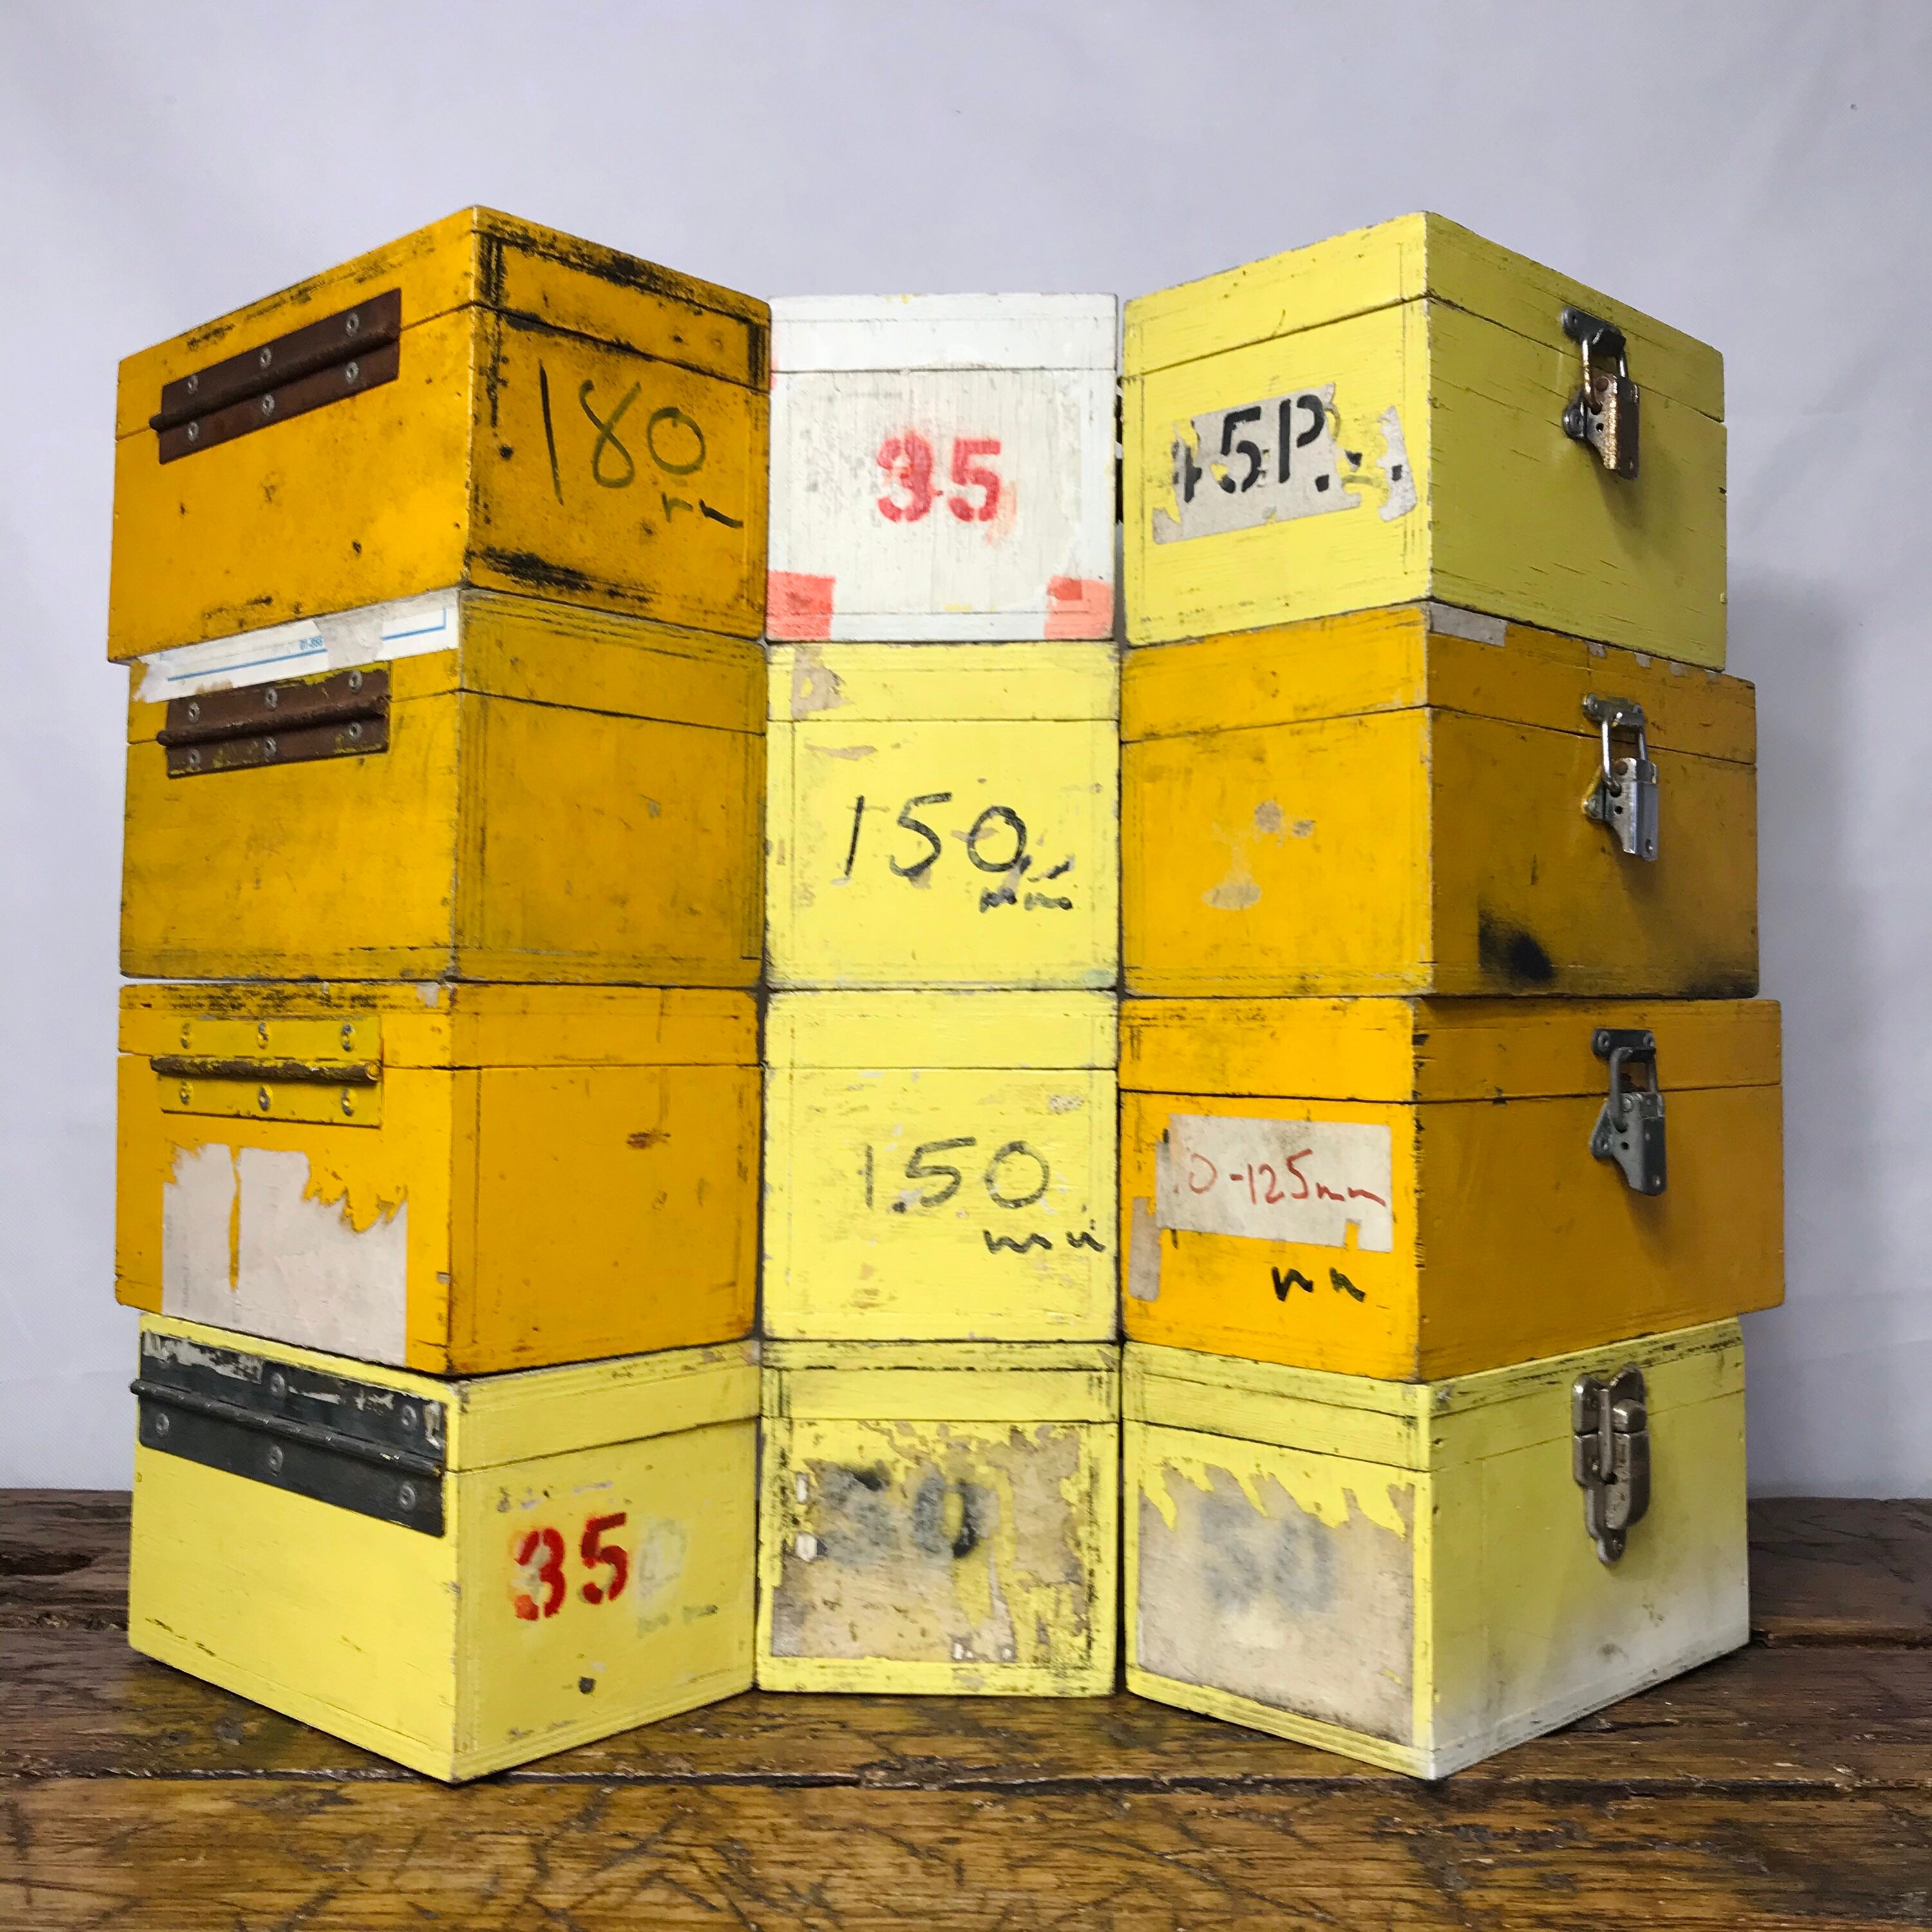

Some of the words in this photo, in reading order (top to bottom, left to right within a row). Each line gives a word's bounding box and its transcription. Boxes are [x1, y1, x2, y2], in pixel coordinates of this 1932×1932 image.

[538, 359, 706, 506] 180
[875, 430, 1002, 524] 35
[843, 791, 1028, 878] 150
[864, 1136, 1050, 1209] 150
[513, 1511, 629, 1622] 35
